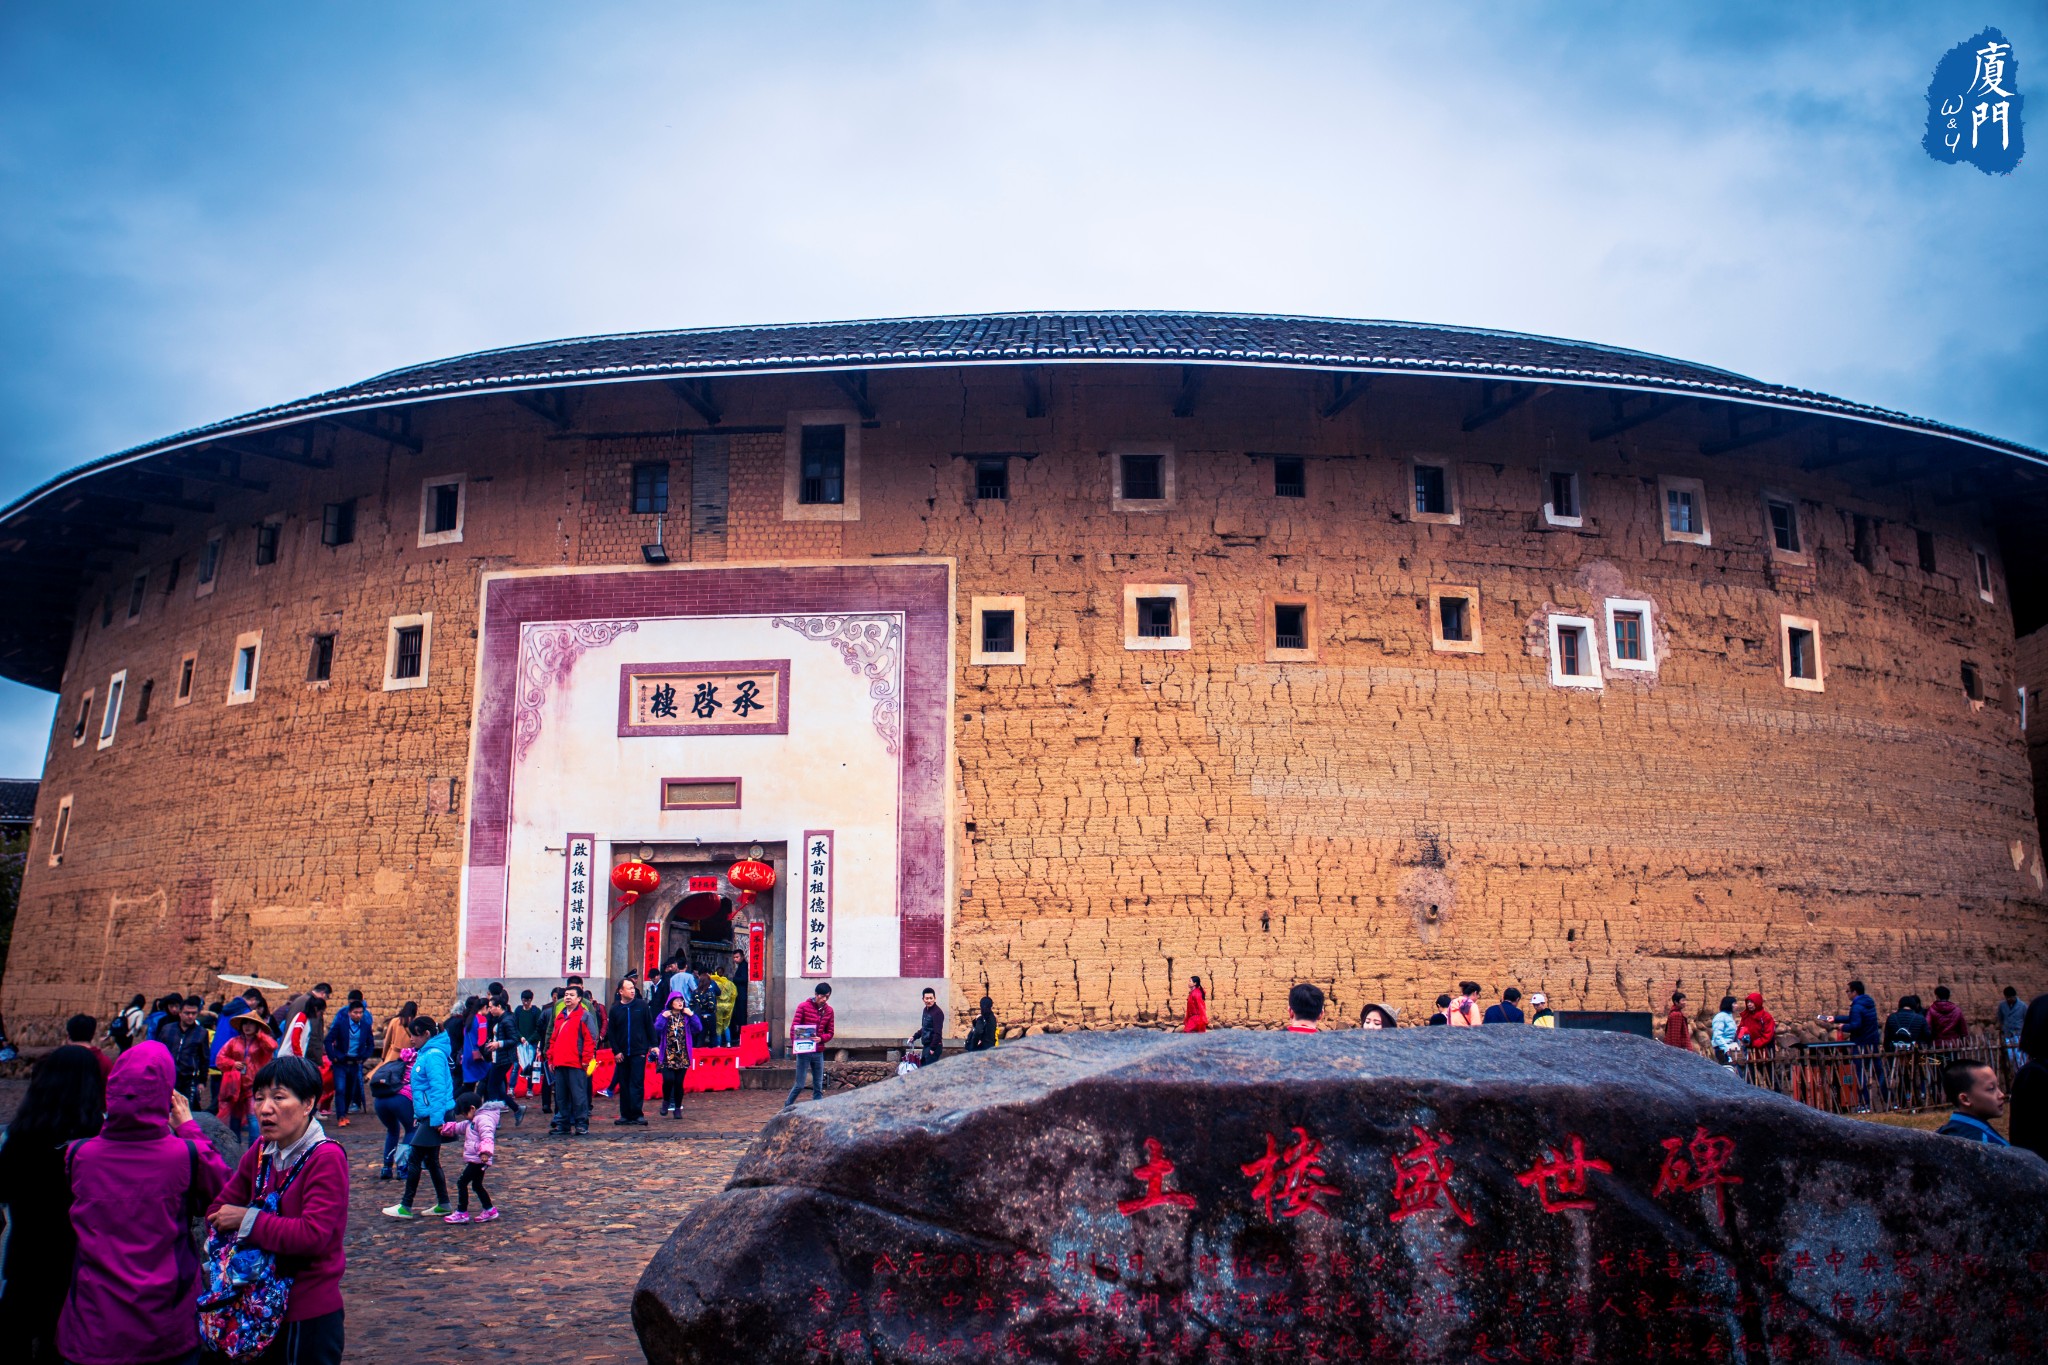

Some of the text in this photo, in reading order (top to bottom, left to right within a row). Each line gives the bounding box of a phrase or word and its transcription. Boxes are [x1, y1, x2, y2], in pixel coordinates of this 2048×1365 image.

[807, 840, 828, 970] 承前祖德勤和儉
